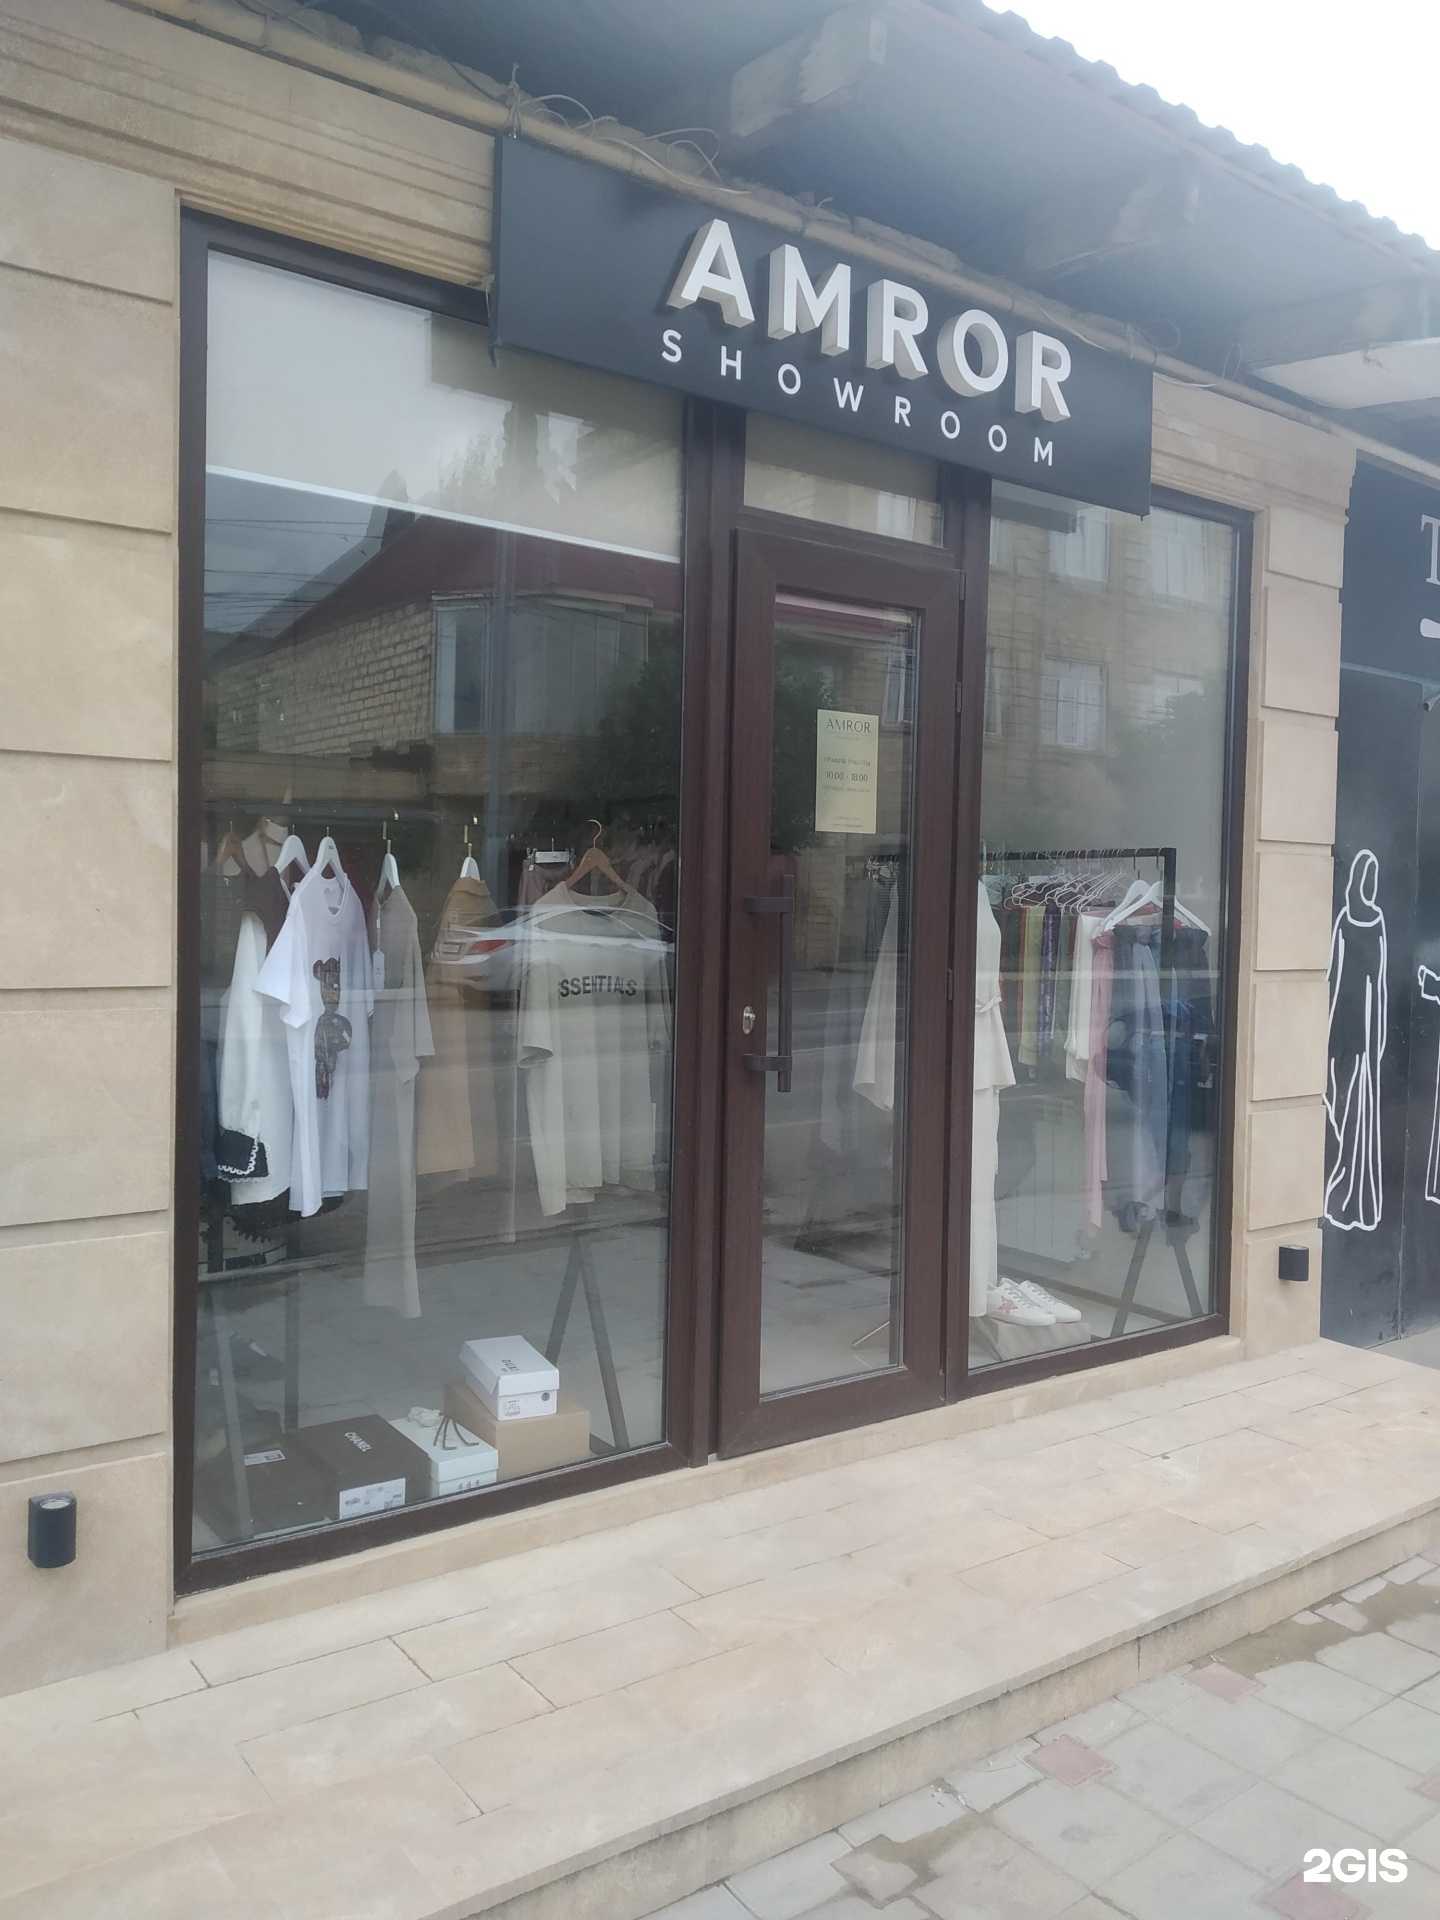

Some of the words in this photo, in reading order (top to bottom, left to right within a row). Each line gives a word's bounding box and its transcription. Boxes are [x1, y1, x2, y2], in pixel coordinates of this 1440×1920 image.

[666, 218, 1072, 423] AMROR
[661, 329, 1054, 467] SHOWROOM
[825, 718, 872, 733] AMROR
